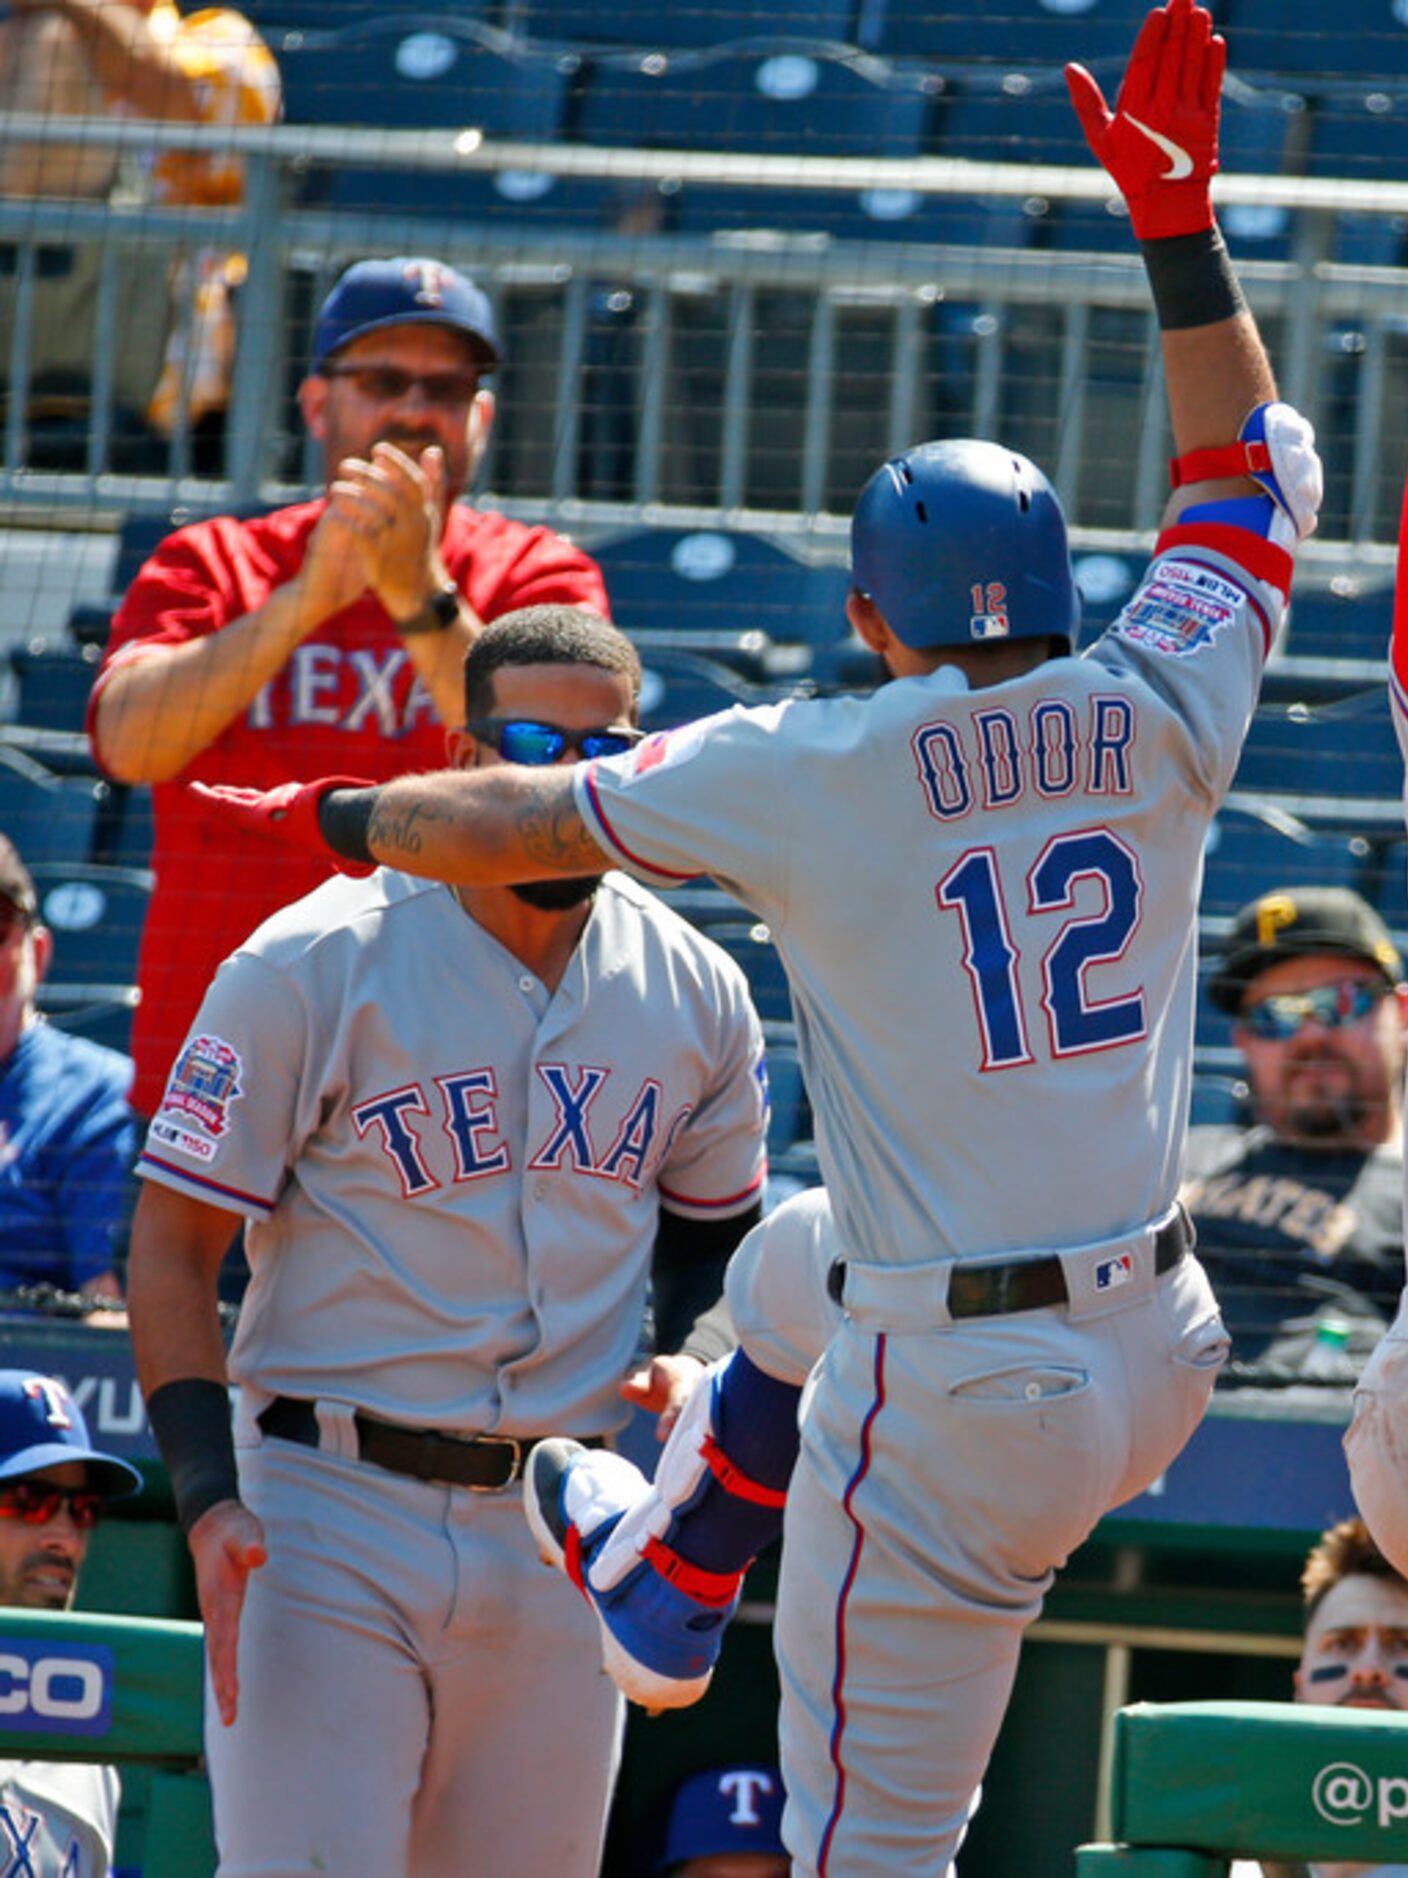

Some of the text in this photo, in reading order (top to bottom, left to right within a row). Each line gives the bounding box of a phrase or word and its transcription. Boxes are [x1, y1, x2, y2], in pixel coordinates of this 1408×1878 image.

[970, 582, 1007, 614] 12
[911, 694, 1137, 822] ODOR
[1257, 894, 1299, 946] P
[935, 826, 1148, 1073] 12
[352, 1062, 695, 1200] TEXA
[22, 1376, 72, 1430] T
[719, 1771, 774, 1828] T
